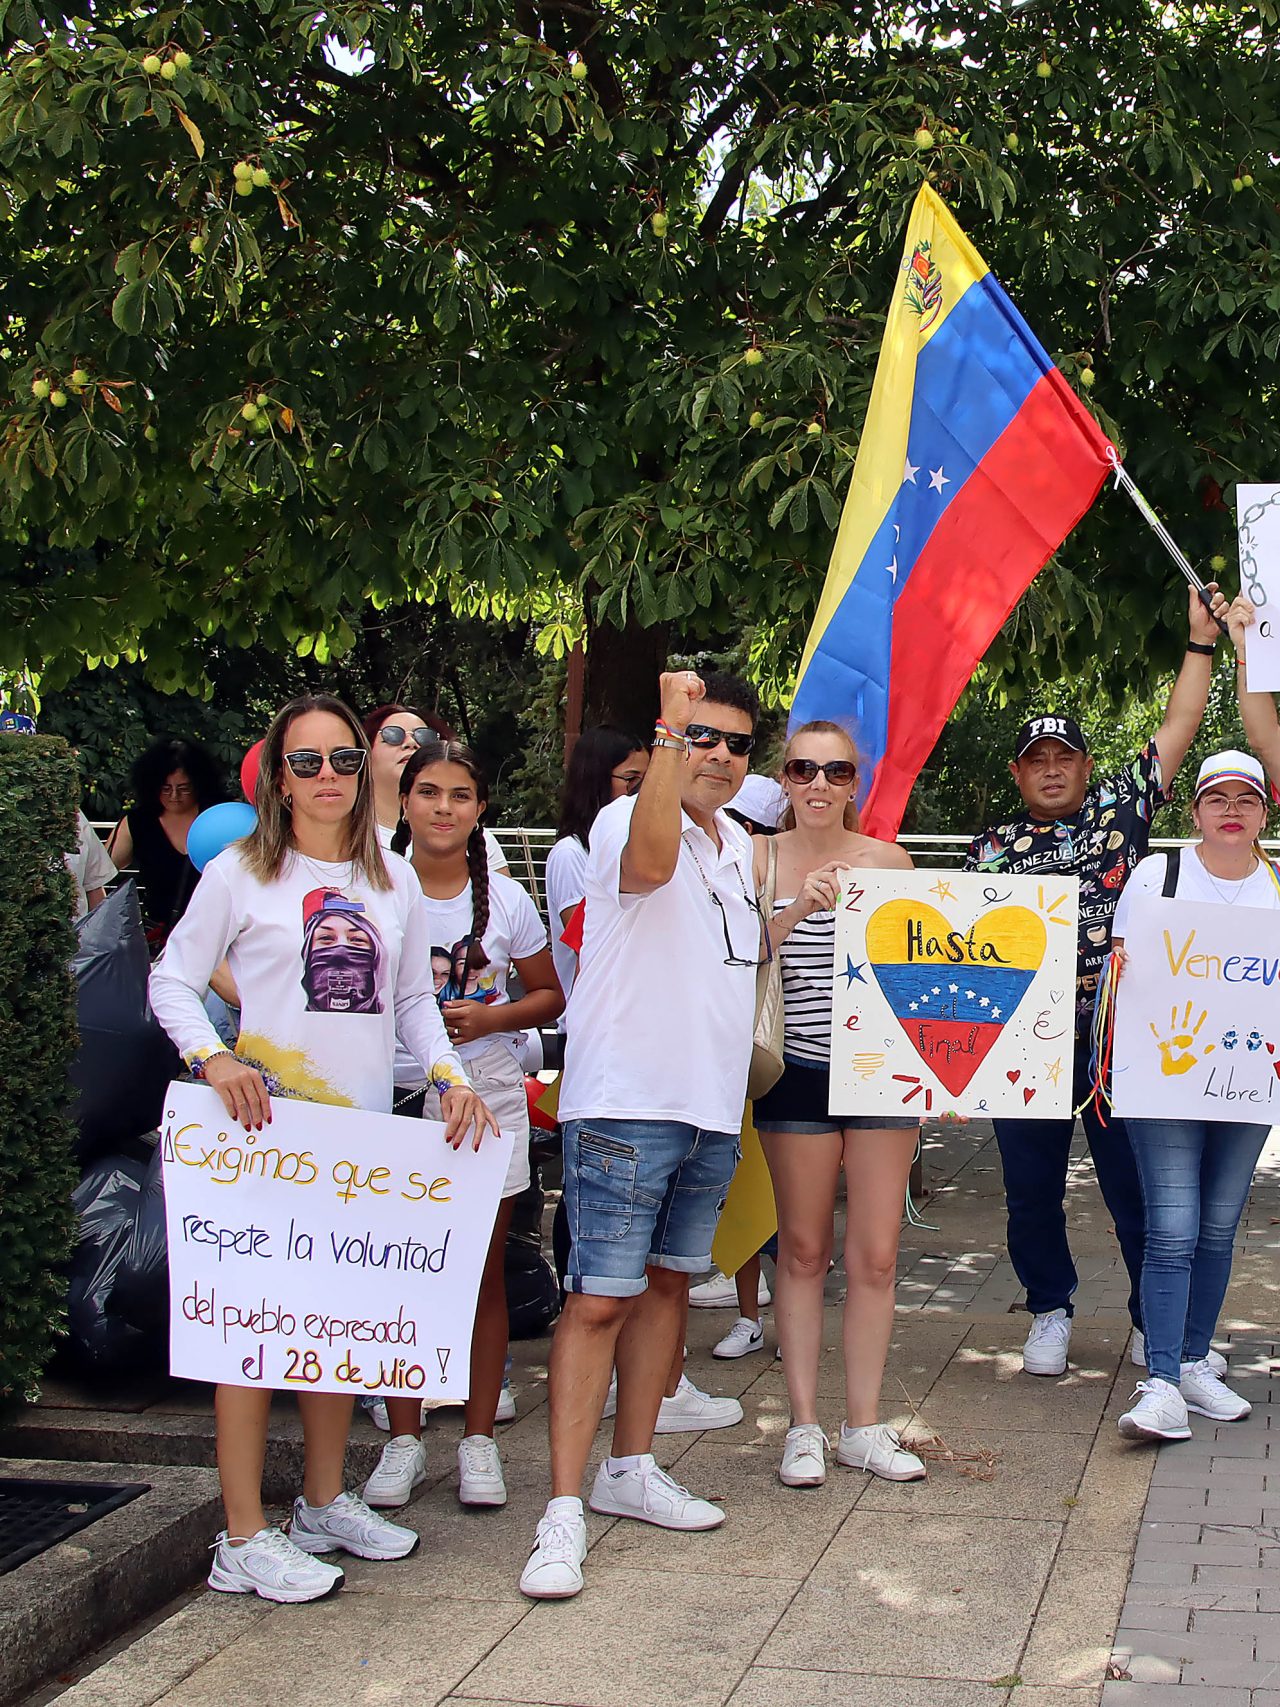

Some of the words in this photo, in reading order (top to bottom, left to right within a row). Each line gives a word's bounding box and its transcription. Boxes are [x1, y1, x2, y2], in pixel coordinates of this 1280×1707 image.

[1259, 621, 1274, 639] a
[1029, 717, 1067, 737] FBI
[907, 919, 1012, 964] Hasta
[919, 1024, 980, 1064] Final
[164, 1110, 318, 1184] ¡Exigimos
[332, 1160, 391, 1204] que
[401, 1172, 452, 1202] se
[183, 1214, 272, 1262] respete
[288, 1218, 313, 1261] la
[182, 1280, 215, 1326] del
[223, 1298, 296, 1344] pueblo
[304, 1304, 417, 1347] expresada
[242, 1344, 264, 1380] el
[284, 1348, 322, 1384] 28
[334, 1348, 363, 1384] de
